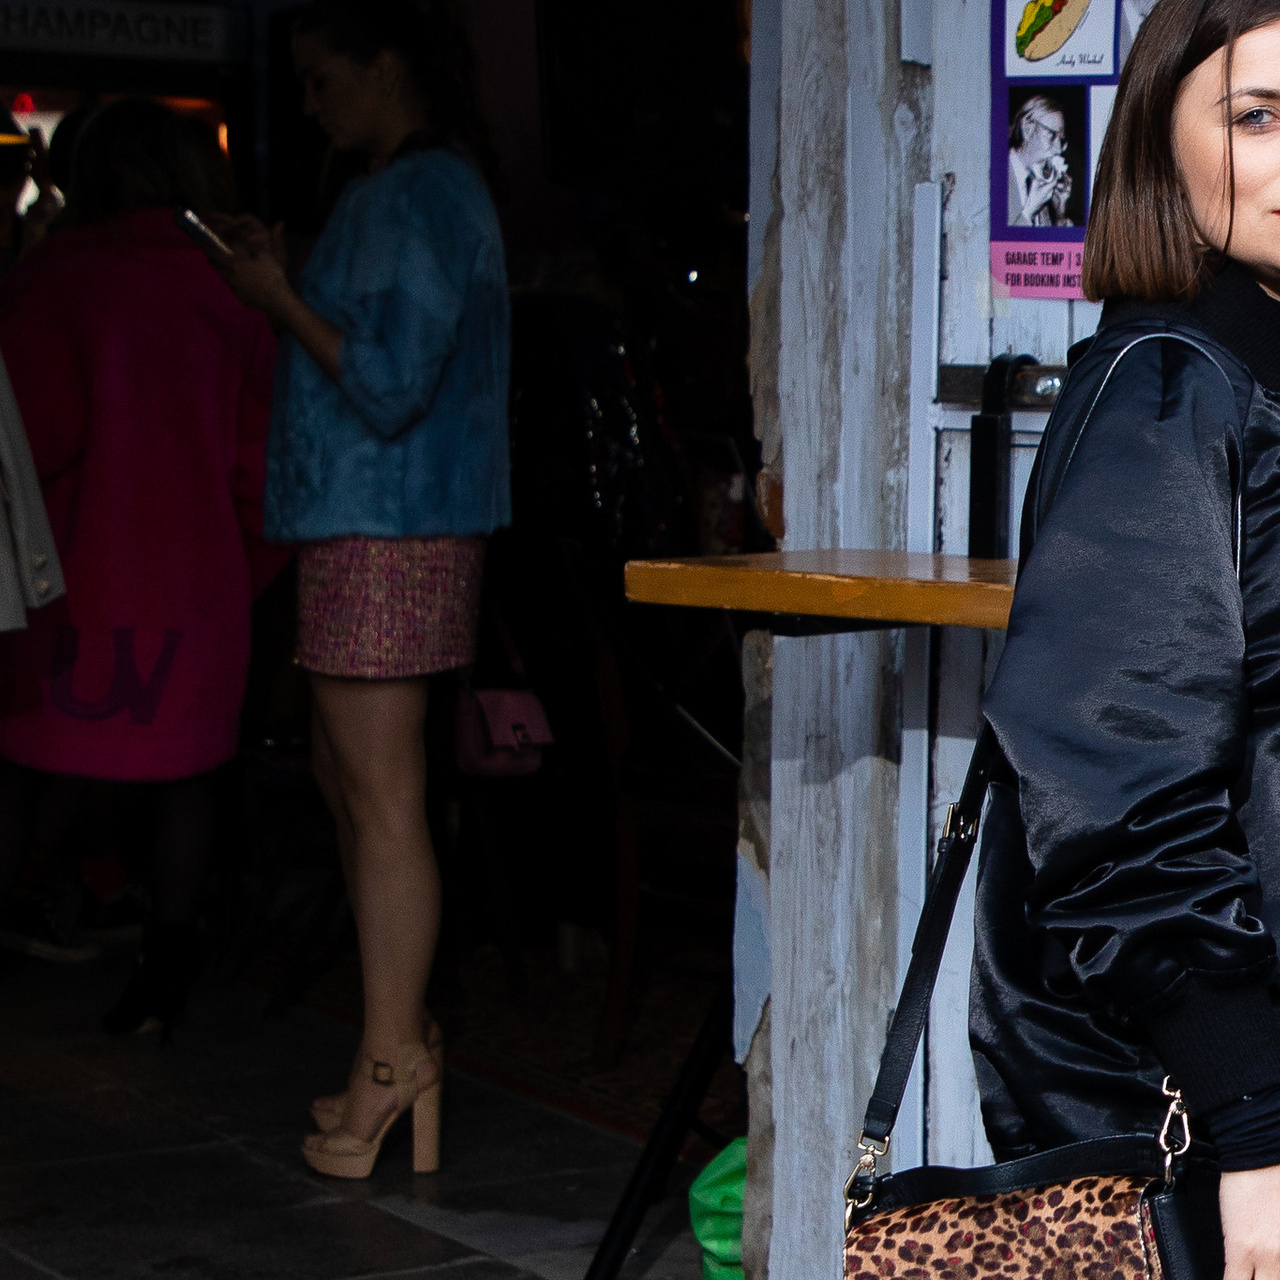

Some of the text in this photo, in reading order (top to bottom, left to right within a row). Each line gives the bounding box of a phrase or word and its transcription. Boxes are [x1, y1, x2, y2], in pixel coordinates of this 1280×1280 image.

[0, 5, 214, 49] HAMPAGNE
[1005, 251, 1038, 266] GARAGE
[1041, 252, 1065, 266] TEMP
[1005, 272, 1022, 287] FOR
[1023, 272, 1061, 287] BOOKING
